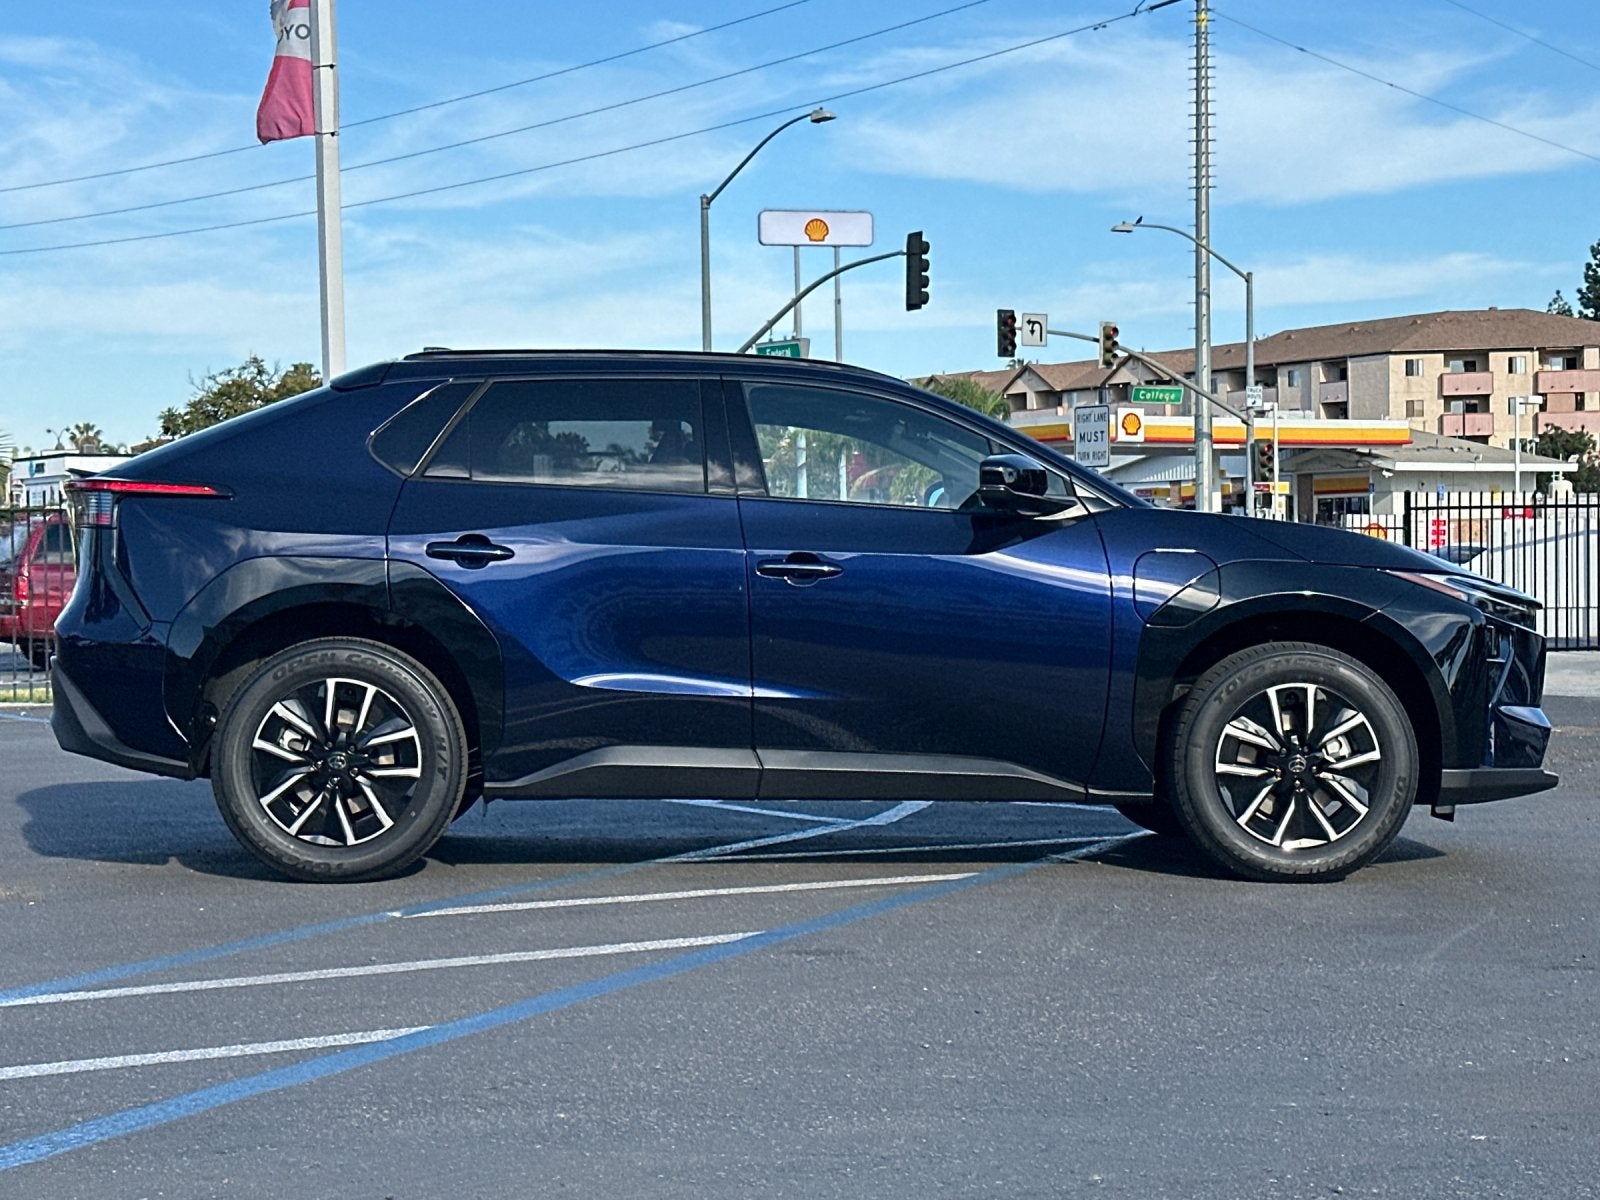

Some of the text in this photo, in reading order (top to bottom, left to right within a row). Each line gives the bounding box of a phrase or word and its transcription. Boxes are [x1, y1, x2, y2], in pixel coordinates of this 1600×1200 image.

[1139, 390, 1176, 402] College
[1077, 411, 1107, 423] RIGHT LANE
[1079, 430, 1105, 443] MUST
[1077, 450, 1107, 461] TURN RIGHT
[272, 652, 337, 681] OPEN
